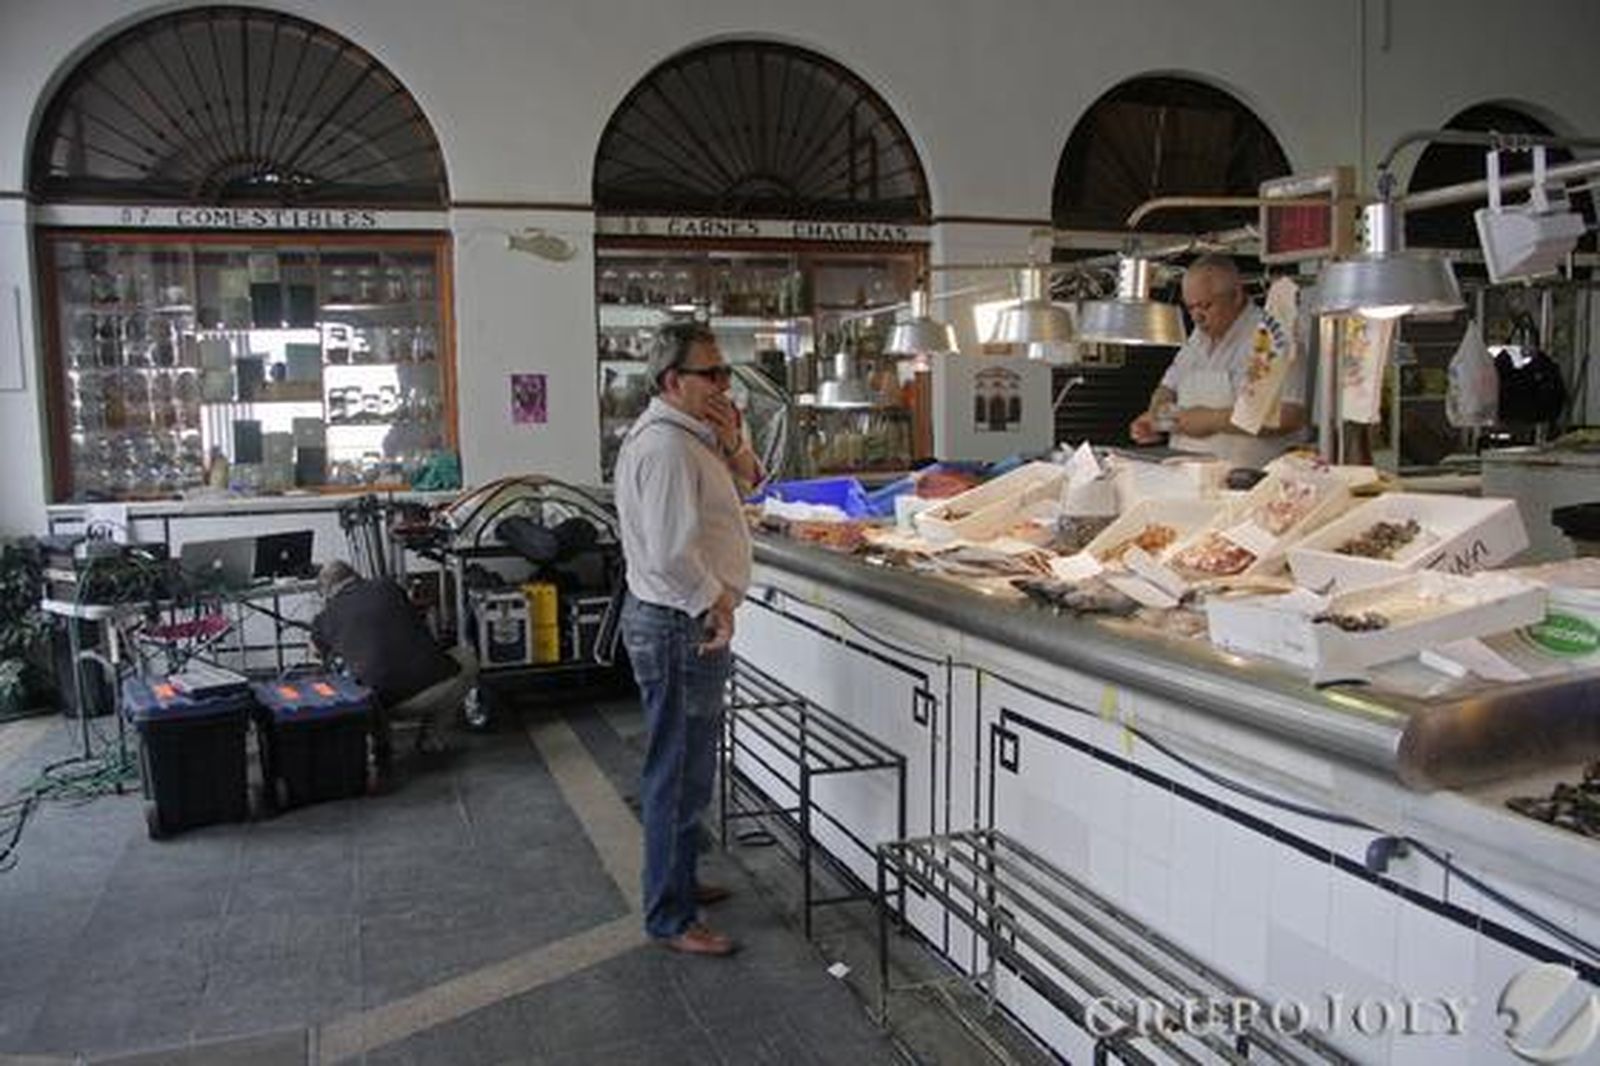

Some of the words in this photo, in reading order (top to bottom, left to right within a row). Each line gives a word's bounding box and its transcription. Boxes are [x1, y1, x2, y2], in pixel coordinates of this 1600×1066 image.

[176, 207, 376, 228] COMESTIBLES
[667, 217, 759, 236] CARNES
[792, 221, 908, 241] CHACINAS
